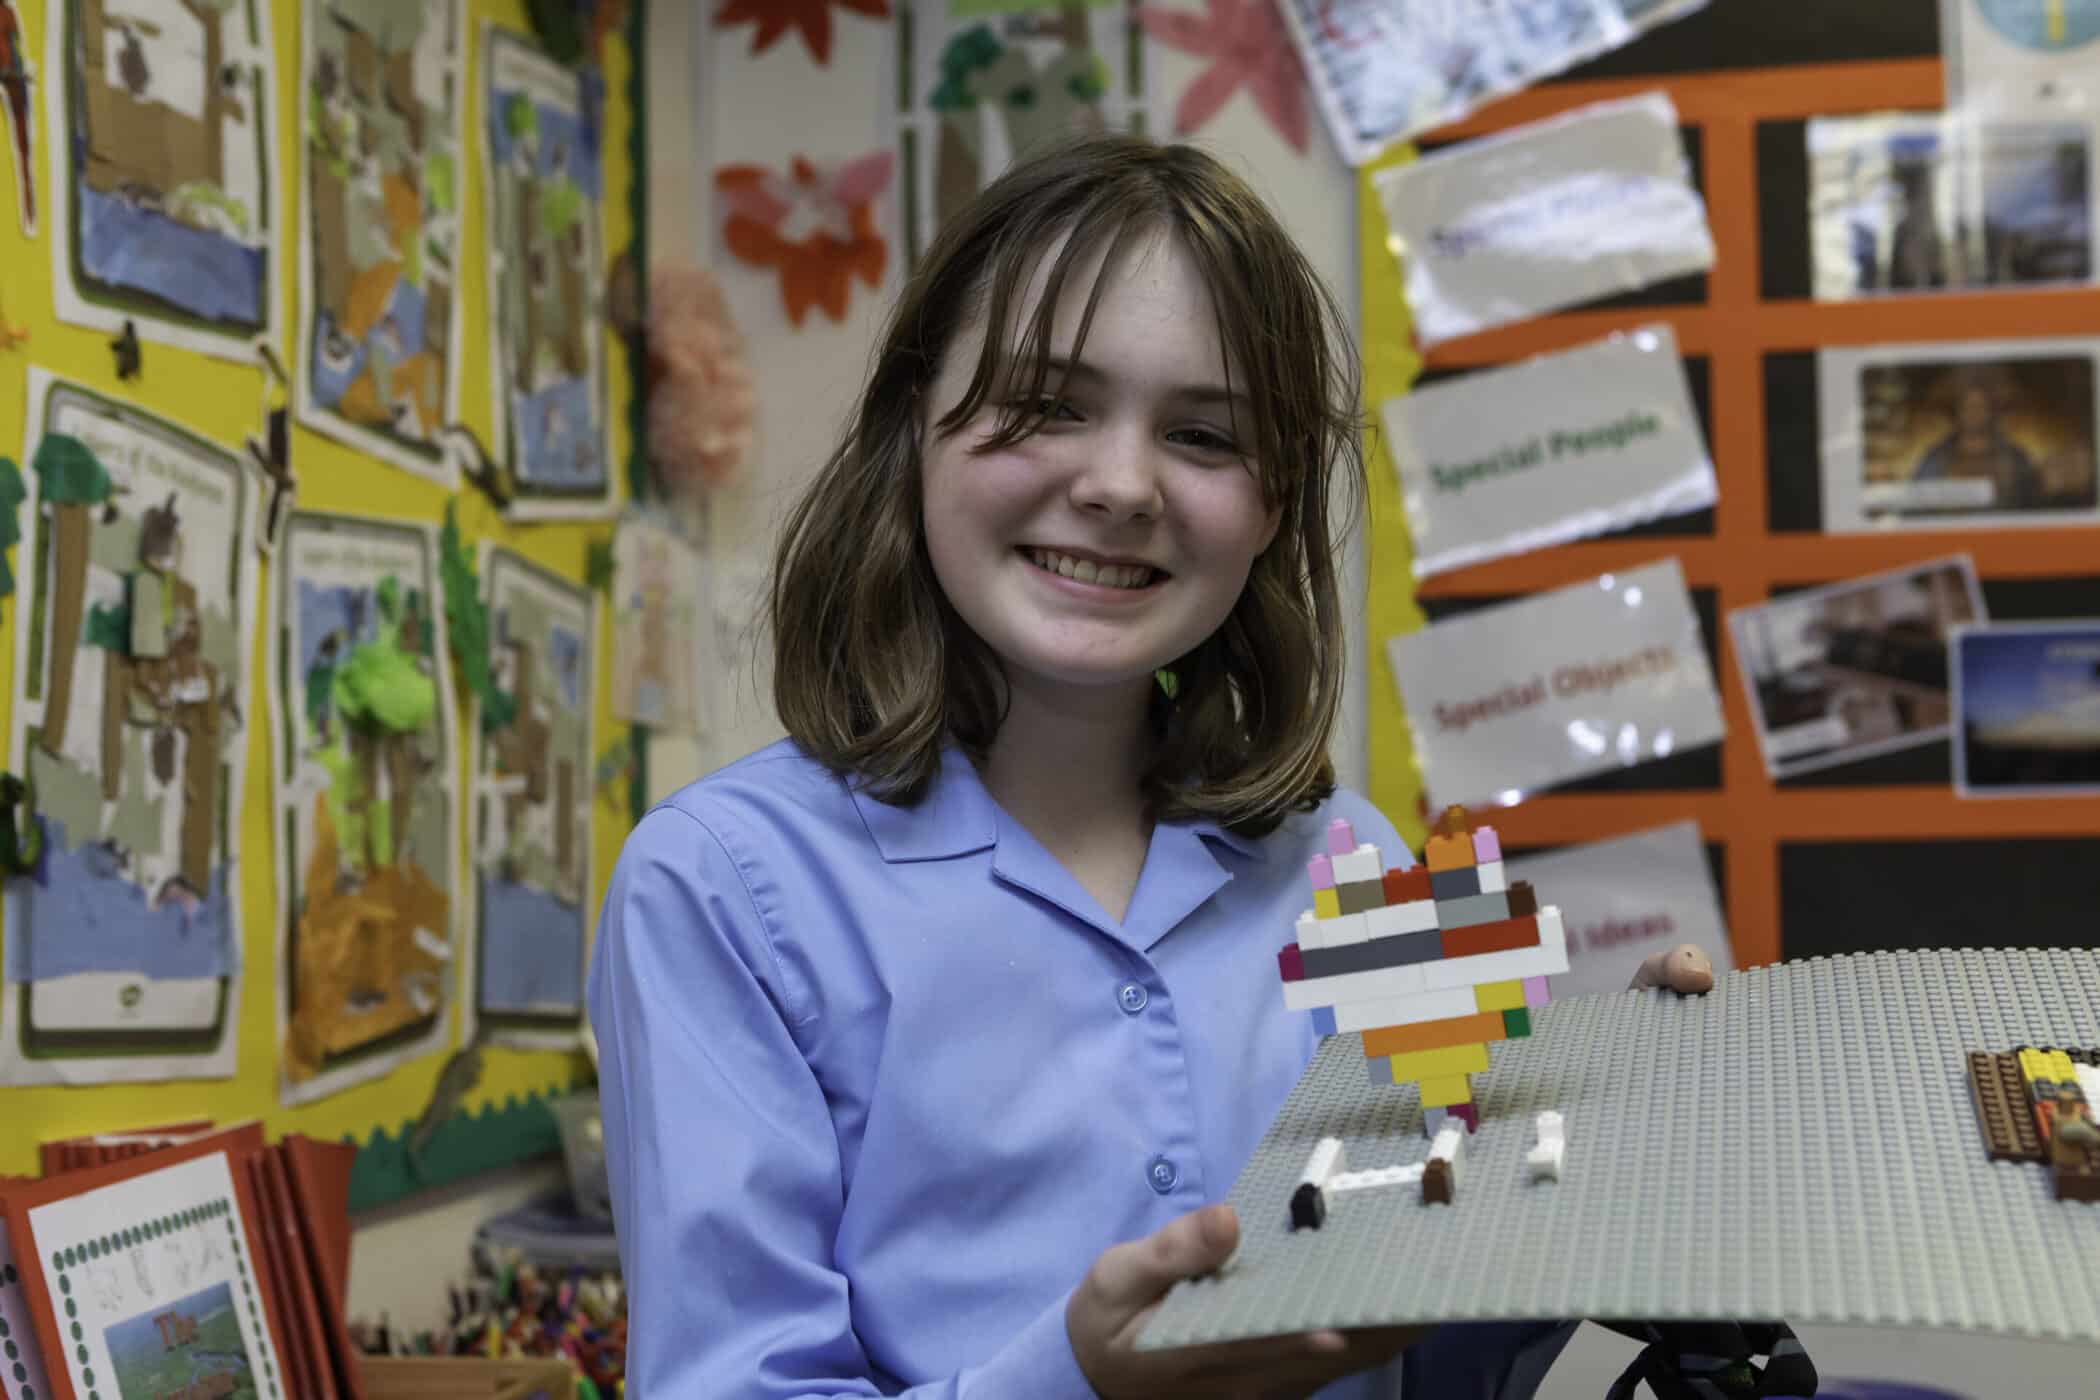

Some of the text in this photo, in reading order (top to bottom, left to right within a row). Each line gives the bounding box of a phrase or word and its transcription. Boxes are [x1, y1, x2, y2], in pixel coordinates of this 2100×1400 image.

[1430, 410, 1660, 493] Special People
[1433, 673, 1547, 732] Special
